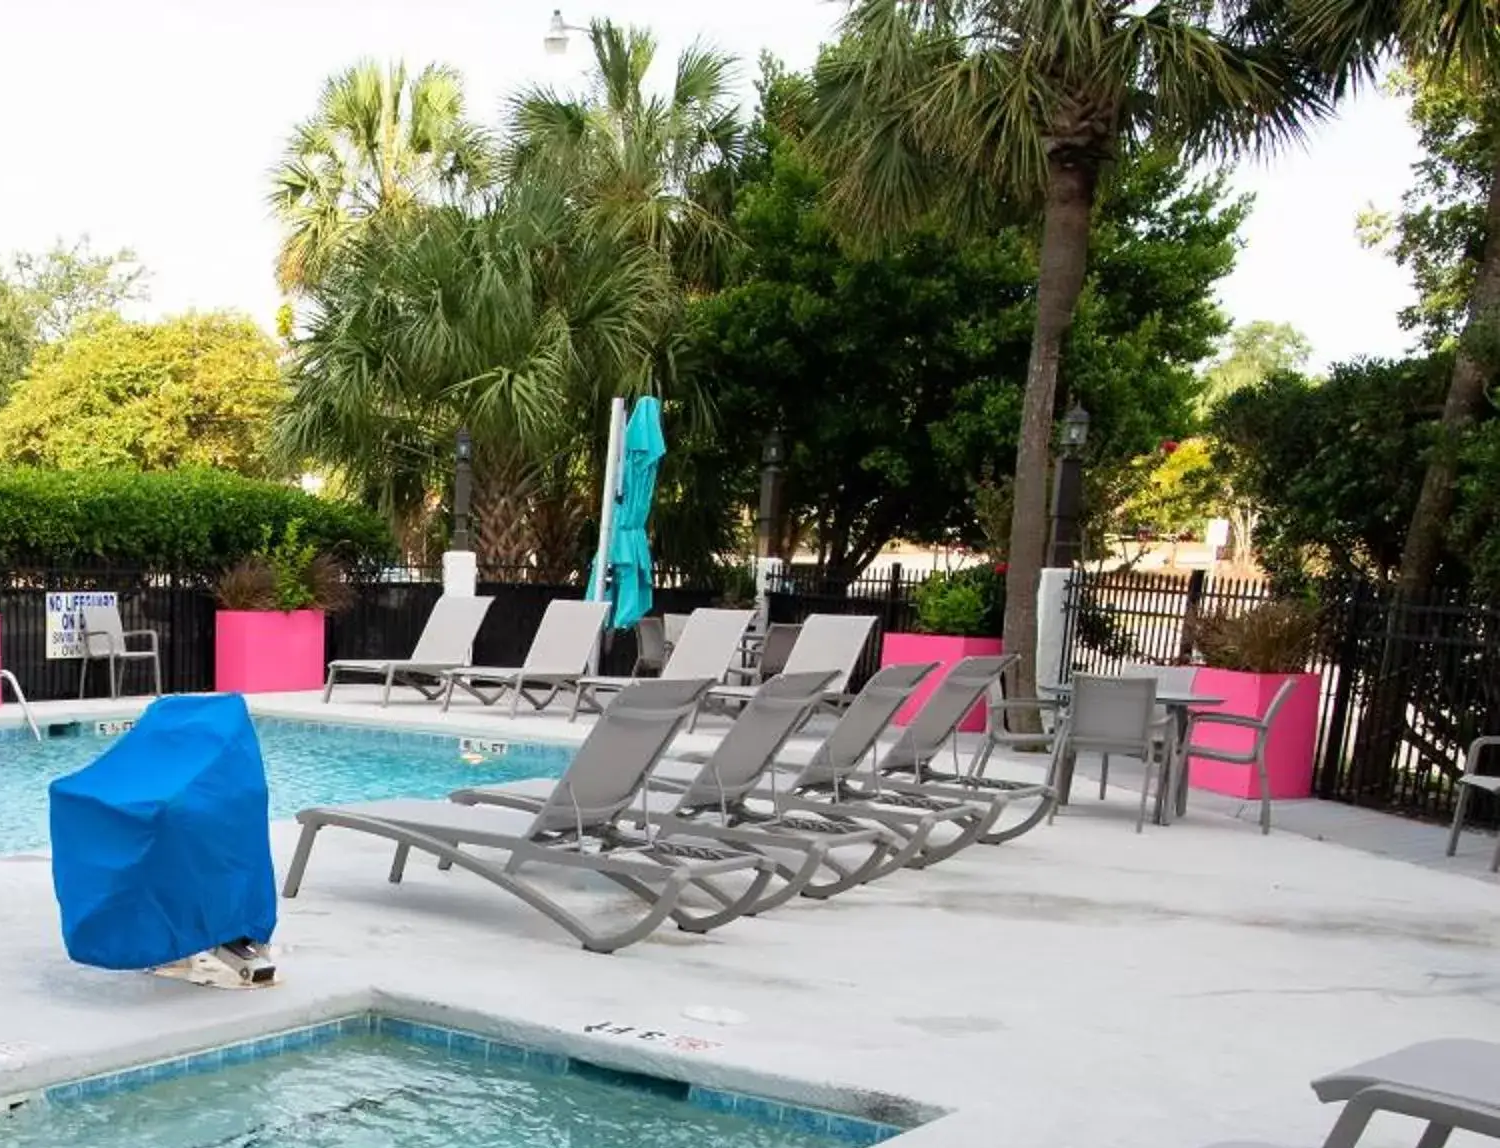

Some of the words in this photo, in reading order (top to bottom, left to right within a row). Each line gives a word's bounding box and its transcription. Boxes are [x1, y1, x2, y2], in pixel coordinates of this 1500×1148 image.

[49, 595, 62, 612] NO
[65, 595, 115, 611] LIFEGUARD
[61, 613, 75, 630] ON
